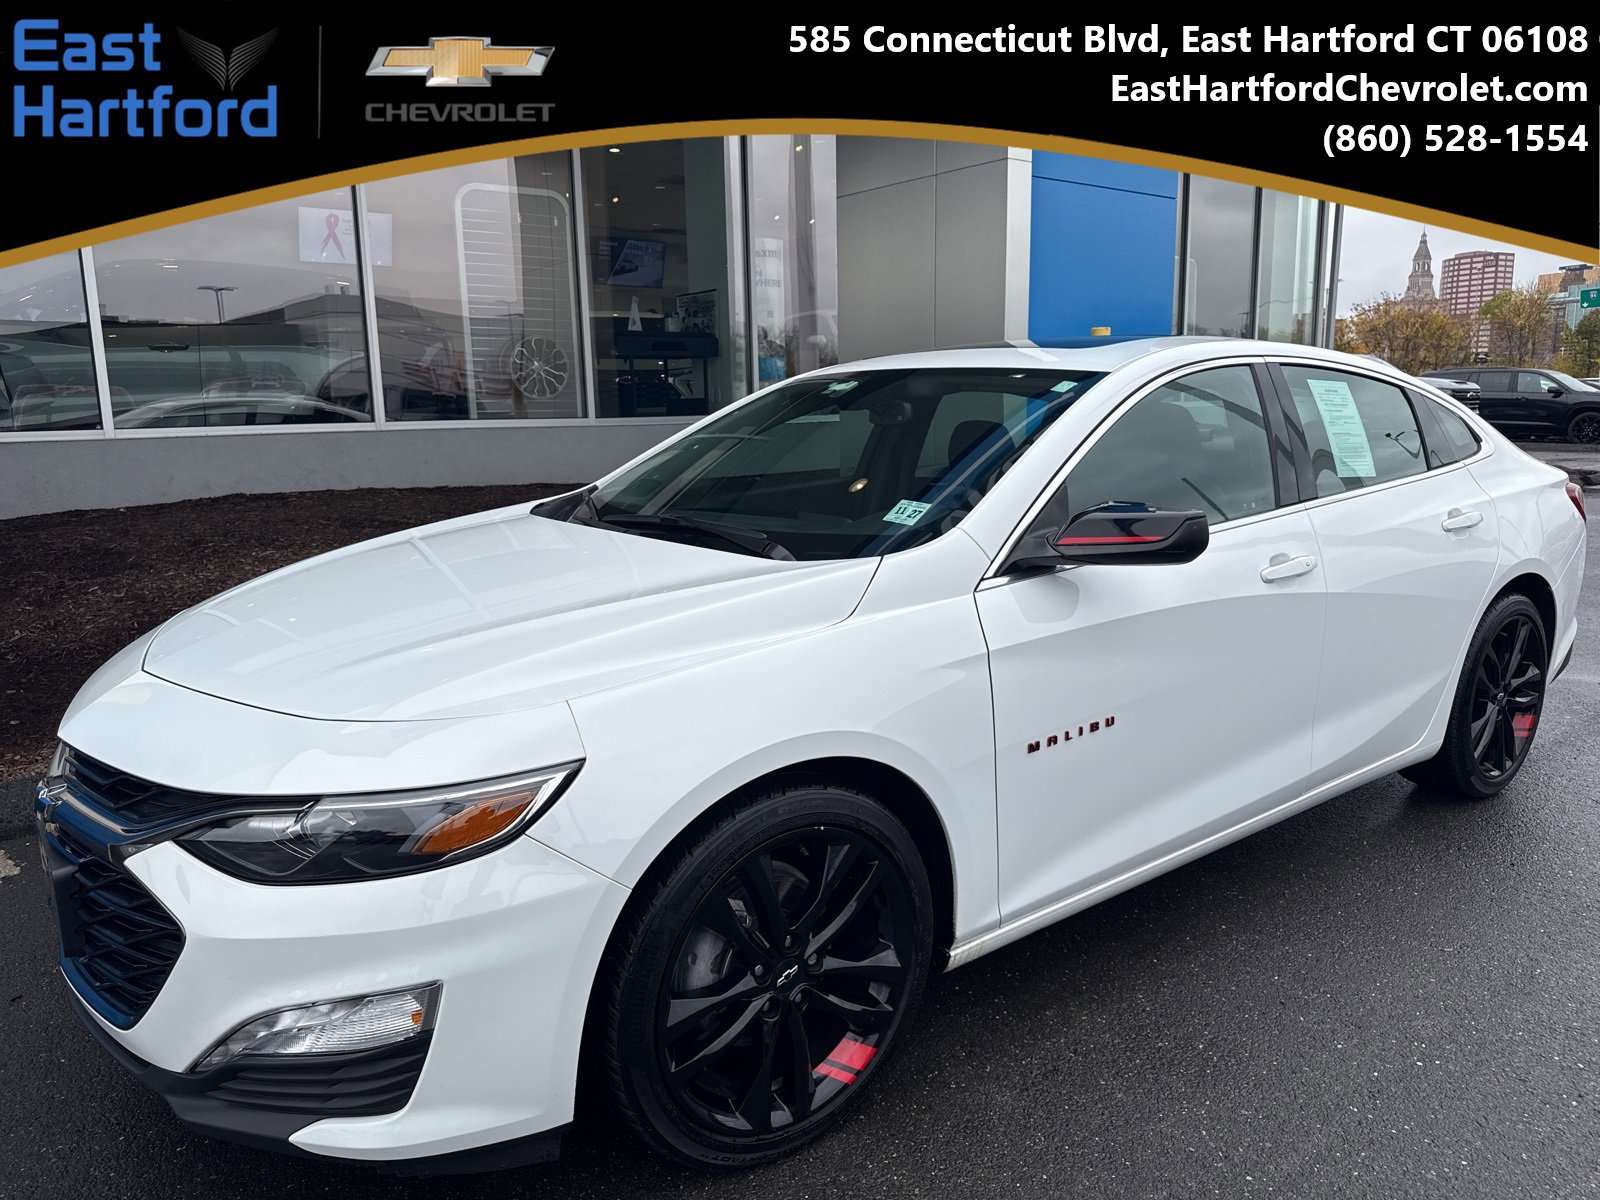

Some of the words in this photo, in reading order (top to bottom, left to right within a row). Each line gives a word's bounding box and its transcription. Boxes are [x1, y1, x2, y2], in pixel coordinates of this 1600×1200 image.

[895, 506, 908, 515] 11
[905, 509, 924, 519] 27
[1027, 715, 1116, 754] MALIBU
